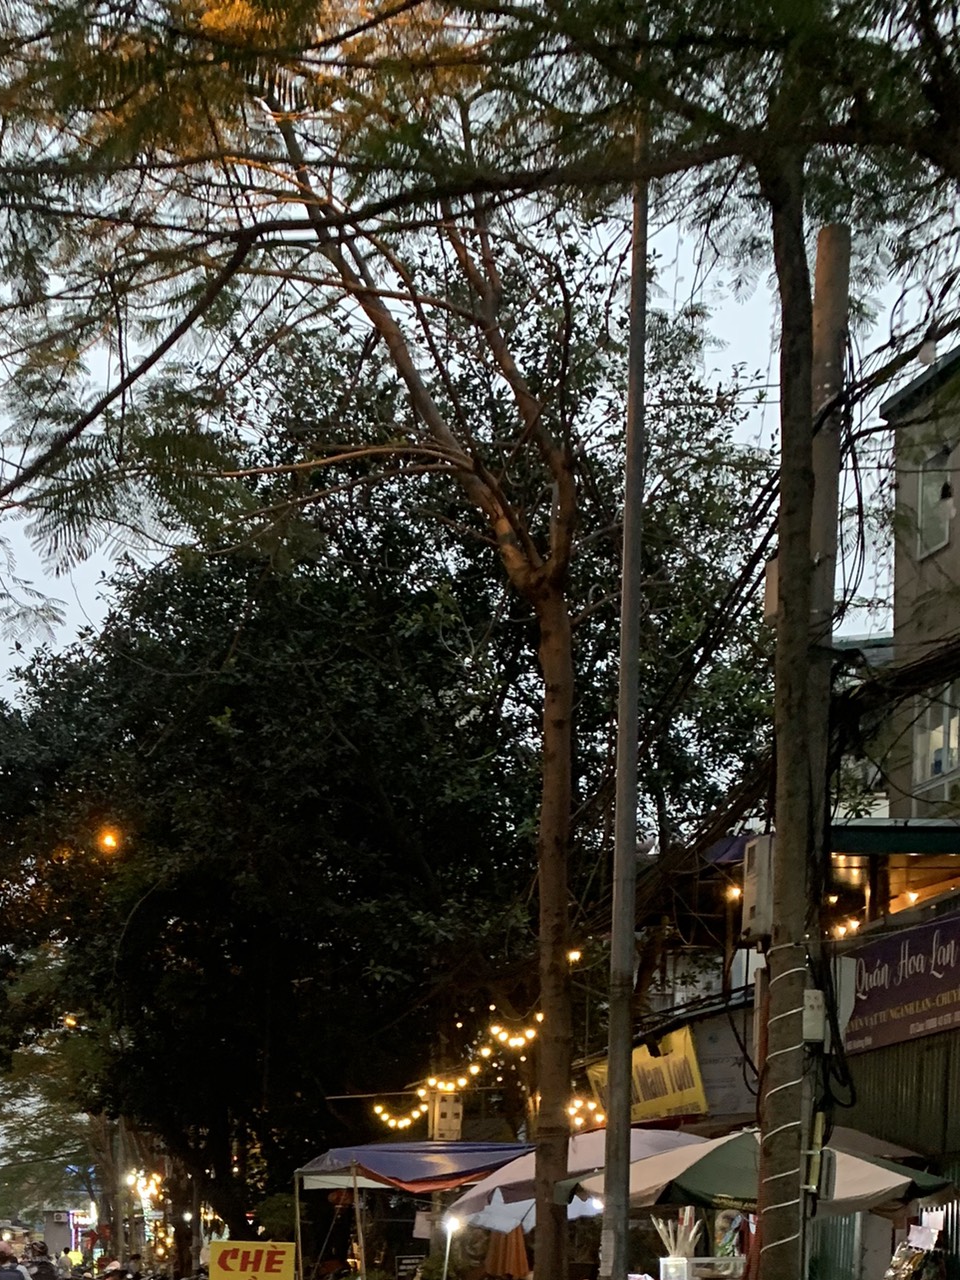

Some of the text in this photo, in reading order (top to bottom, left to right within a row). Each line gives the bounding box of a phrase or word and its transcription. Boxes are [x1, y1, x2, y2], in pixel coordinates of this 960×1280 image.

[856, 929, 956, 1000] Quán Hoa Lan
[217, 1244, 286, 1273] CHÈ
